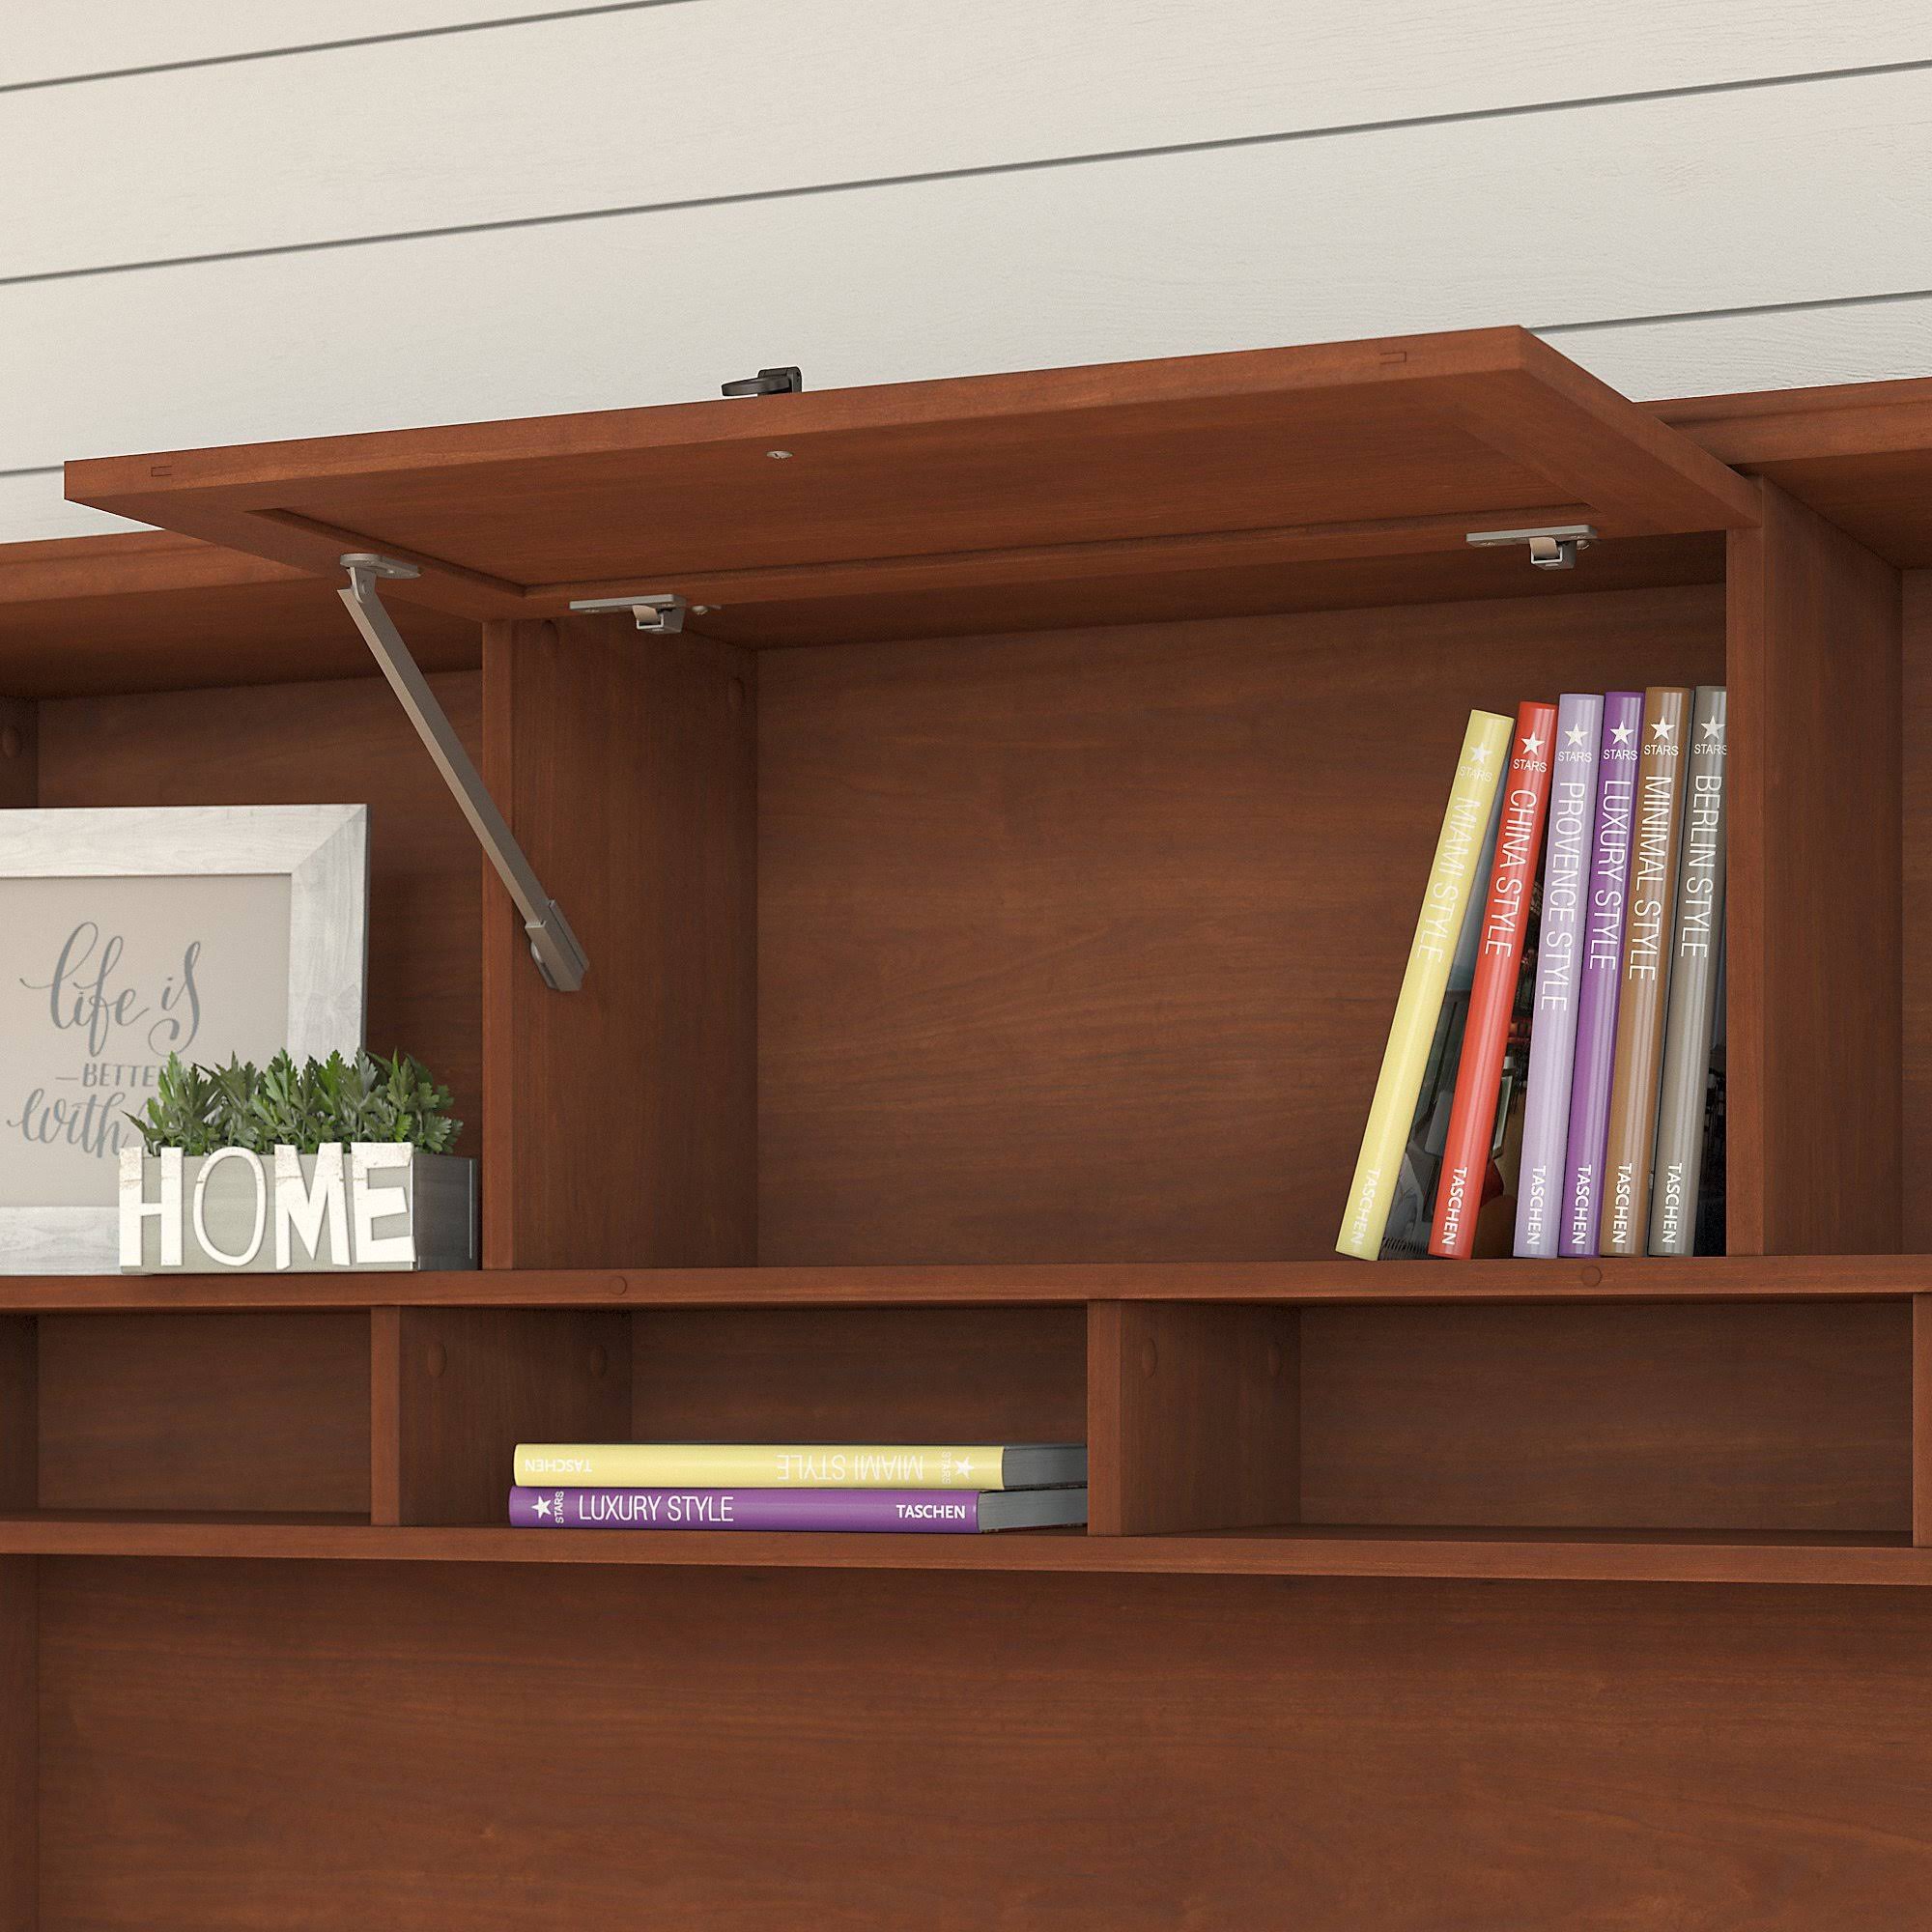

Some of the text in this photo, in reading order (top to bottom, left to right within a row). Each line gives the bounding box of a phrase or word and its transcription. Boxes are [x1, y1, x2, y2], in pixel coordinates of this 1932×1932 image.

[1460, 764, 1492, 782] STARS
[1513, 758, 1548, 773] STARS
[1557, 751, 1592, 763] STARS
[1603, 749, 1638, 760] STARS
[1643, 744, 1679, 756] STARS
[1694, 744, 1726, 754] STARS
[1413, 796, 1482, 963] MIAMI STYLE
[1485, 789, 1538, 957] CHINA STYLE
[1541, 781, 1585, 1011] PROVENCE STYLE
[1590, 780, 1632, 971] LUXURY STYLE
[1629, 776, 1672, 980] MINIMAL STYLE
[1681, 775, 1722, 958] BERLIN STYLE
[18, 922, 201, 1057] life is
[82, 1063, 167, 1088] BETTE
[7, 1088, 129, 1158] with
[119, 1142, 416, 1270] HOME
[1350, 1167, 1381, 1244] TASCHEN
[1441, 1166, 1468, 1246] TASCHEN
[1526, 1165, 1547, 1245] TASCHEN
[1572, 1164, 1592, 1244] TASCHEN
[1612, 1162, 1633, 1244] TASCHEN
[1662, 1162, 1683, 1244] TASCHEN
[525, 1459, 592, 1472] TASCHEN
[776, 1454, 923, 1481] MIAMI STYLE
[941, 1451, 952, 1485] STARS
[554, 1491, 564, 1524] STARS
[579, 1494, 734, 1522] LUXURY STYLE
[895, 1504, 966, 1520] TASCHEN
